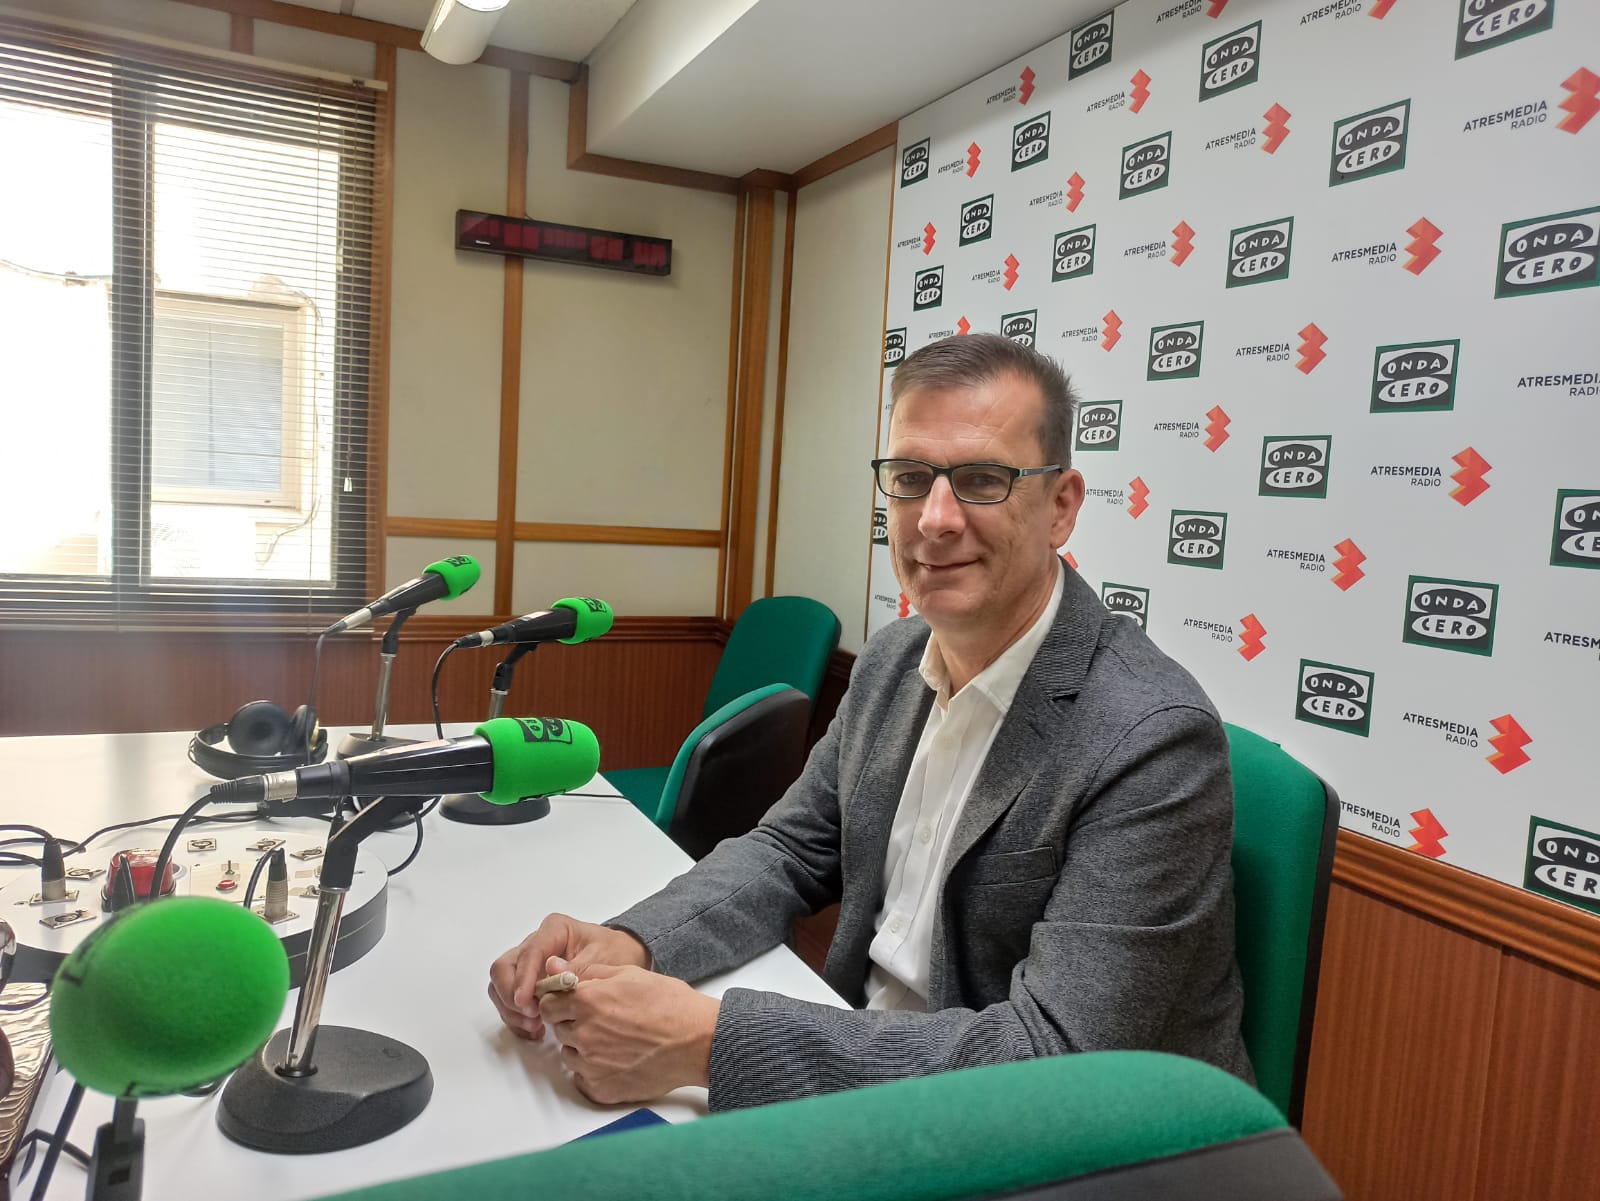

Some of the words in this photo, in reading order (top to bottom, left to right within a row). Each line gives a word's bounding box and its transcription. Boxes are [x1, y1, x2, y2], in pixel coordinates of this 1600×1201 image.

[1182, 5, 1202, 18] RADIO
[1300, 0, 1358, 25] ATRESMED
[1335, 3, 1361, 20] RADIO
[1476, 4, 1535, 36] CERO
[1077, 27, 1106, 47] ONDA
[1077, 45, 1105, 65] CERO
[1210, 40, 1250, 65] ONDA
[1211, 61, 1248, 85] CERO
[1087, 91, 1125, 113] ATRESMEDIA
[1463, 100, 1548, 132] ATRESMEDIA
[1510, 113, 1548, 131] RADIO
[1018, 126, 1043, 144] ONDA
[1205, 127, 1256, 150] ATRESMEDIA
[1344, 121, 1393, 145] ONDA
[1018, 142, 1042, 160] CERO
[1234, 136, 1256, 150] RADIO
[906, 151, 925, 164] ONDA
[1129, 149, 1162, 166] ONDA
[1344, 144, 1392, 168] CERO
[906, 163, 924, 177] CERO
[1129, 166, 1160, 185] CERO
[1029, 190, 1062, 207] ATRESMEDIA
[965, 208, 987, 220] ONDA
[965, 221, 987, 236] CERO
[1060, 239, 1088, 253] ONDA
[1124, 240, 1167, 257] ATRESMEDIA
[1238, 234, 1281, 253] ONDA
[1516, 229, 1585, 253] ONDA
[1147, 249, 1166, 259] RADIO
[1331, 242, 1397, 262] ATRESMEDIA
[1368, 253, 1397, 266] RADIO
[1060, 255, 1087, 270] CERO
[1239, 255, 1279, 274] CERO
[1517, 256, 1582, 280] CERO
[918, 277, 938, 288] ONDA
[919, 290, 938, 301] CERO
[1006, 321, 1030, 333] ONDA
[1061, 327, 1098, 338] ATRESMEDIA
[886, 337, 902, 345] NDA
[1157, 335, 1192, 349] ONDA
[1236, 343, 1290, 356] ATRESMEDIA
[1266, 353, 1290, 362] RADIO
[1157, 355, 1191, 368] CERO
[1387, 358, 1441, 374] ONDA
[1517, 373, 1600, 388] ATRESMEDI
[1387, 382, 1439, 398] CERO
[1569, 386, 1600, 396] RADI
[1084, 413, 1113, 423] ONDA
[1154, 421, 1199, 432] ATRESMEDIA
[1084, 430, 1112, 440] CERO
[1272, 450, 1317, 463] ONDA
[1273, 471, 1315, 484] CERO
[1370, 466, 1441, 477] ATRESMEDIA
[1410, 477, 1441, 487] RADIO
[1085, 488, 1124, 498] ATRESMEDIA
[1179, 524, 1215, 535] ONDA
[1179, 542, 1213, 555] CERO
[1575, 535, 1600, 551] CE
[1267, 549, 1325, 563] ATRESMEDIA
[1300, 562, 1325, 572] RADIO
[1108, 596, 1139, 609] ONDA
[1421, 593, 1479, 612] ONDA
[1183, 618, 1233, 635] ATRESMEDIA
[1421, 618, 1477, 637] CERO
[1211, 632, 1233, 643] RADIO
[1544, 631, 1600, 649] ATRESM
[1310, 676, 1358, 696] ONDA
[1311, 698, 1356, 718] CERO
[1402, 712, 1479, 738] ATRESMEDIA
[1445, 733, 1478, 749] RADIO
[1340, 800, 1401, 828] TRESMEDIA
[1371, 822, 1401, 838] RADIO
[1546, 840, 1600, 864] OND
[1547, 867, 1598, 894] CER
